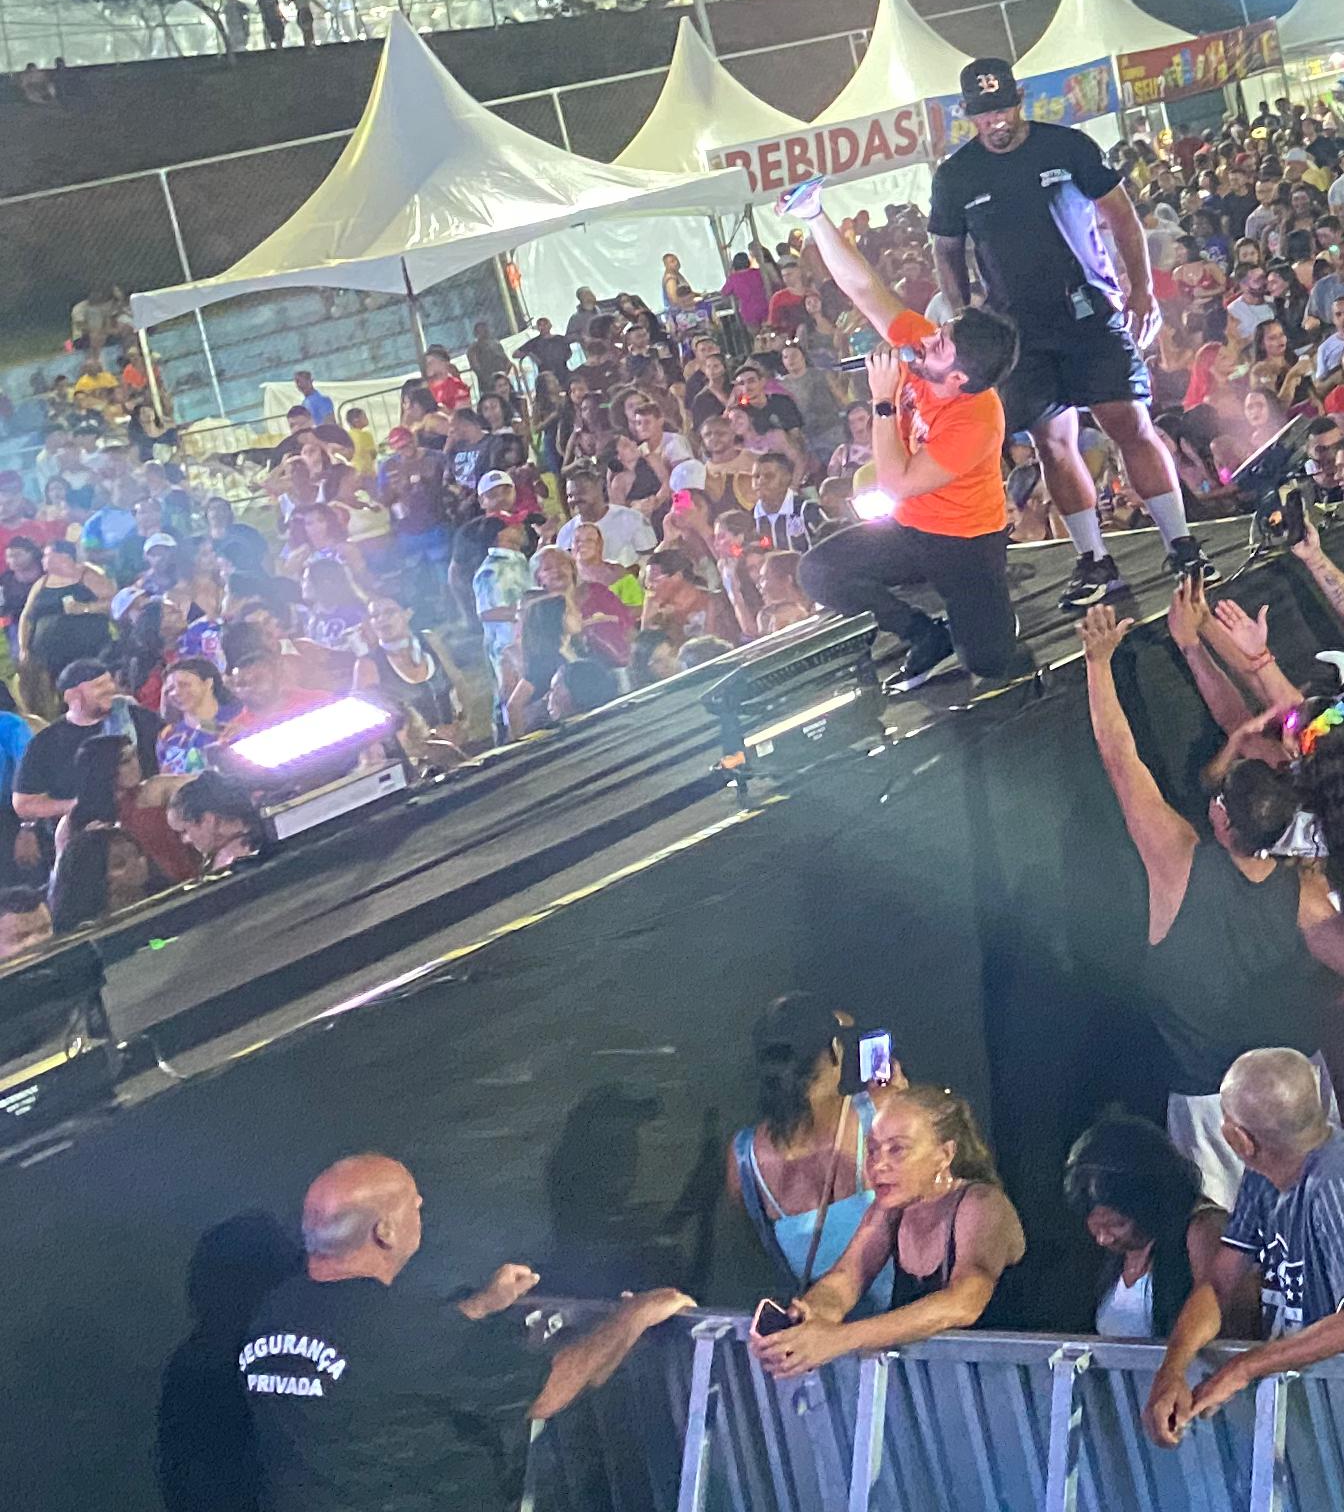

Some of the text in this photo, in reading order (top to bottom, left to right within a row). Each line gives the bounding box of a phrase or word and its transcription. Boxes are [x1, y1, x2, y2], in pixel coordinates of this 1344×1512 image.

[725, 109, 918, 192] BEBIDAS
[238, 1334, 346, 1380] SEGURANÇA
[247, 1374, 323, 1396] PRIVADA
